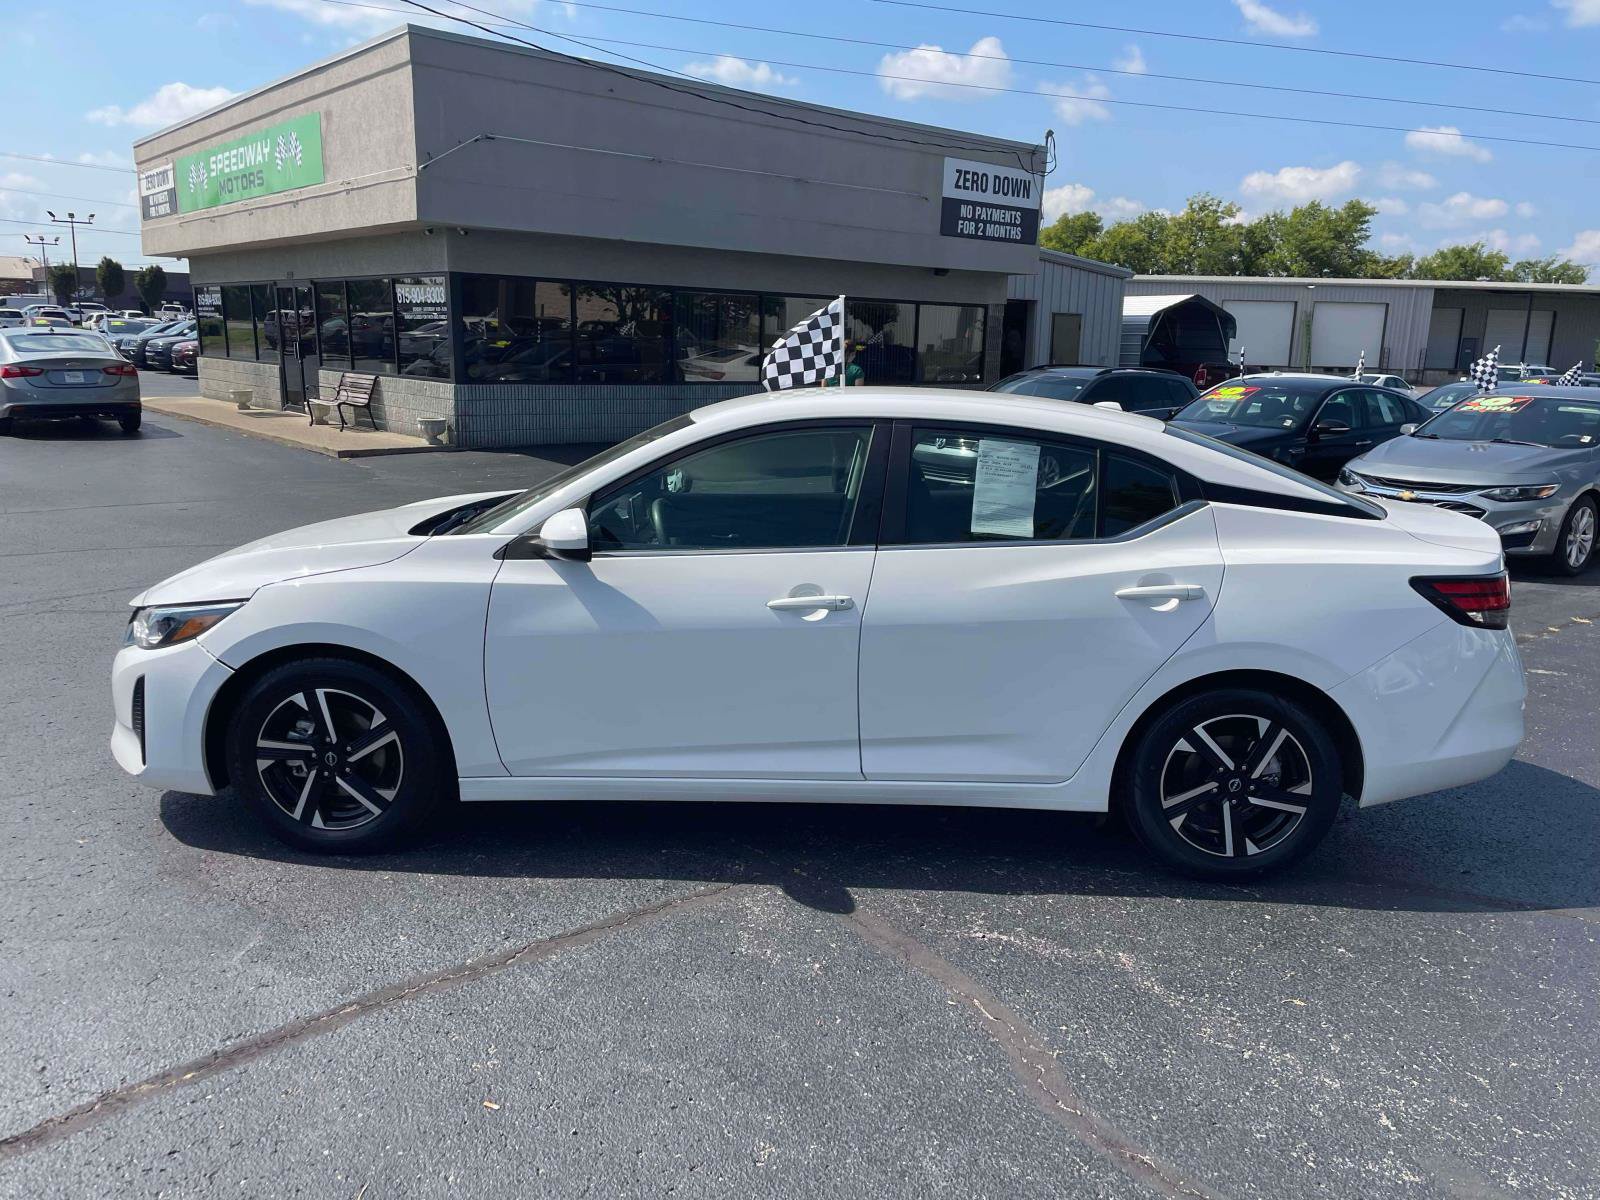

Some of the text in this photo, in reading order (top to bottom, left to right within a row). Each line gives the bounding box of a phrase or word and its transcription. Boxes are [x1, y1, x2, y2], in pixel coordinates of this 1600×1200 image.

[210, 139, 270, 177] SPEEDWAY
[217, 169, 265, 197] MOTORS
[954, 168, 1031, 199] ZERO DOWN
[960, 204, 1021, 224] NO PAYMENTS
[957, 220, 1021, 240] FOR 2 MONTHS
[397, 286, 445, 303] 615-904-9303
